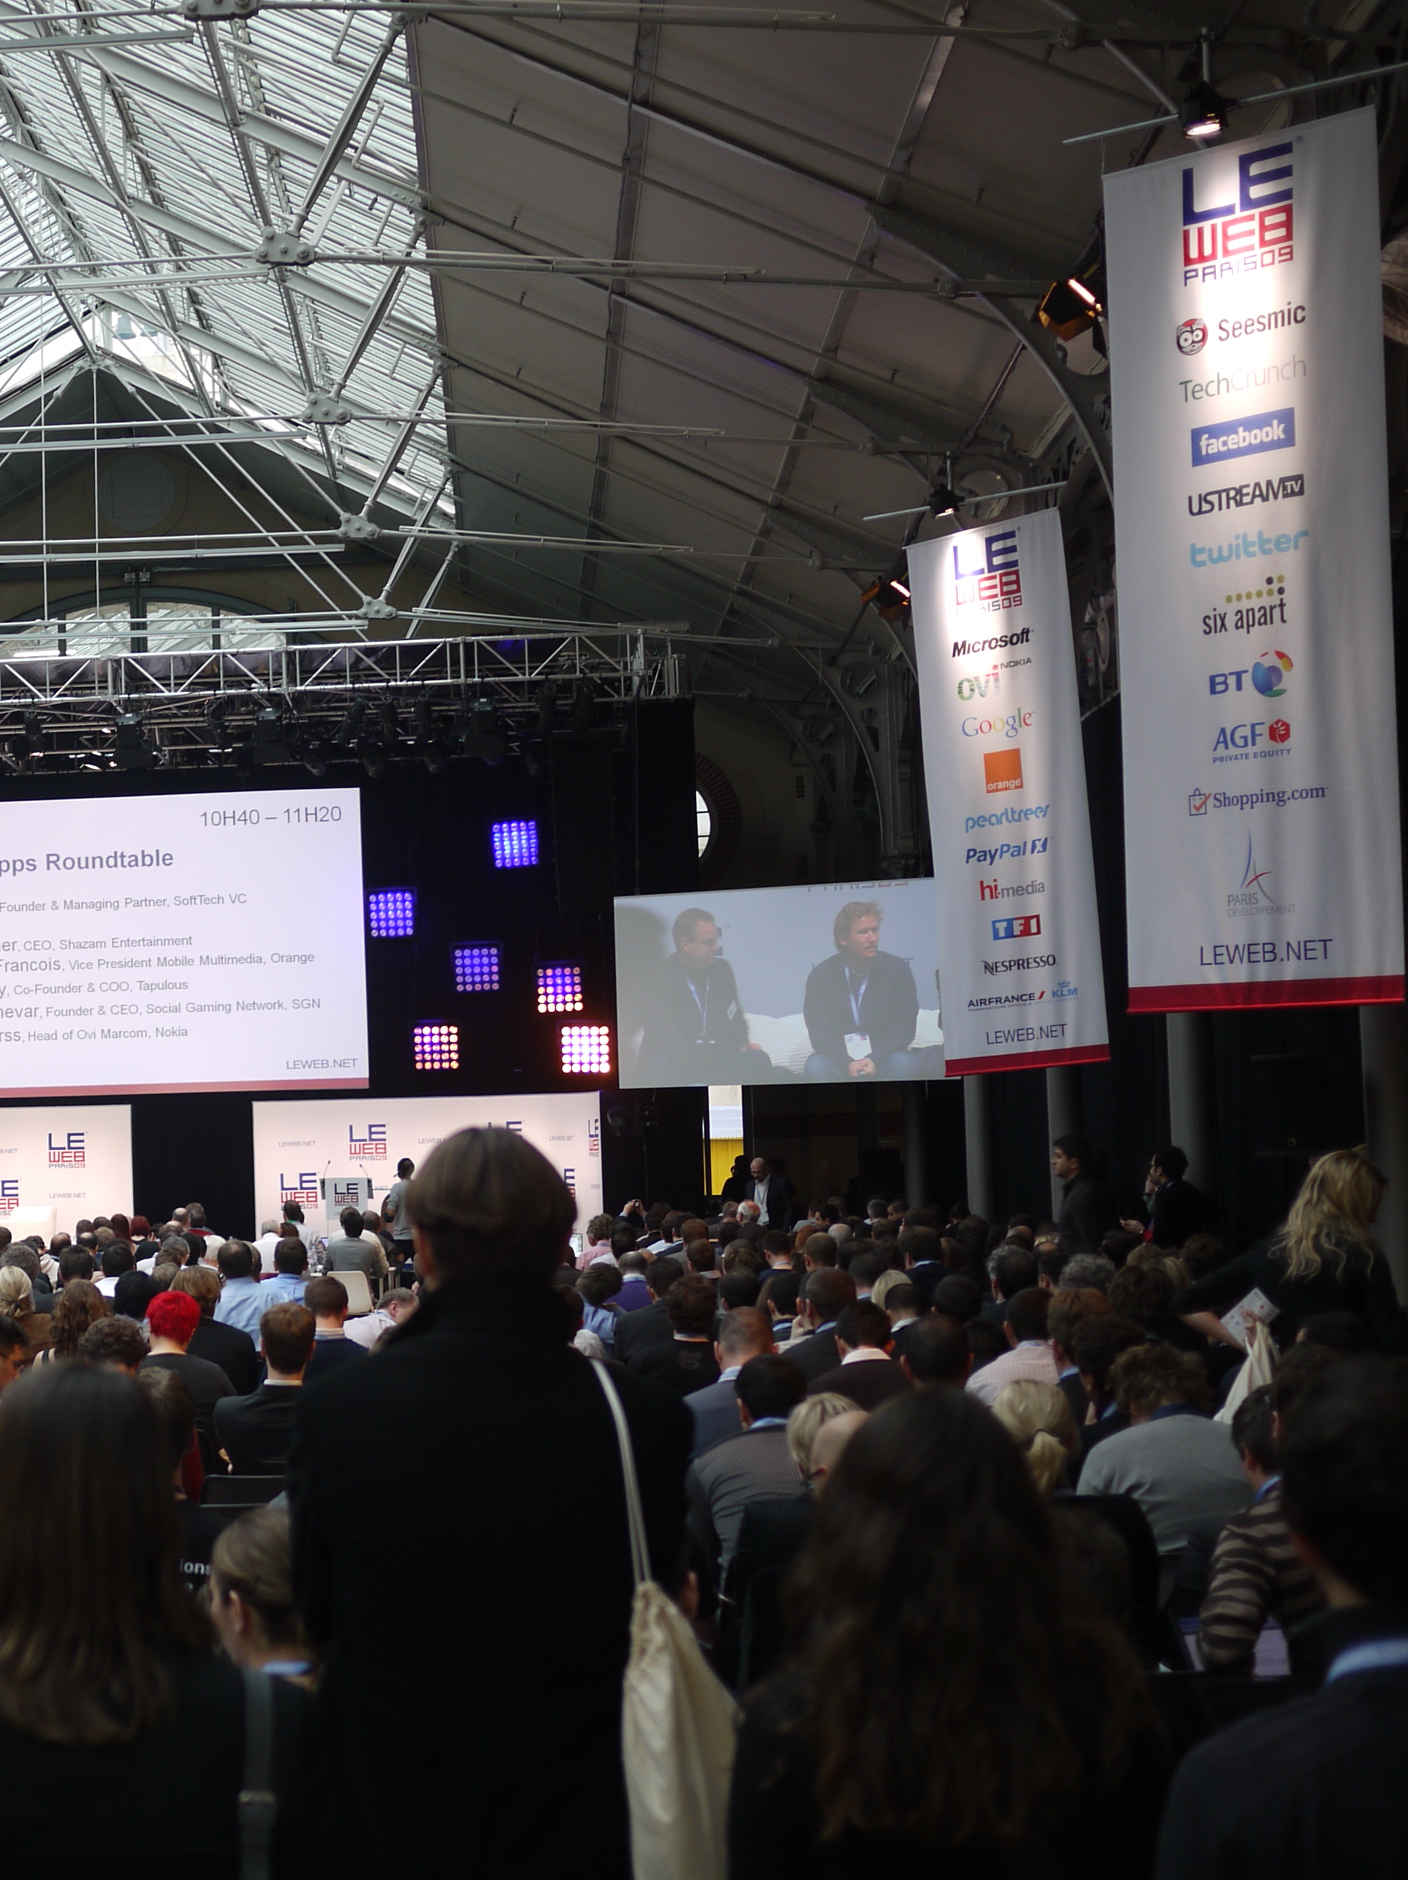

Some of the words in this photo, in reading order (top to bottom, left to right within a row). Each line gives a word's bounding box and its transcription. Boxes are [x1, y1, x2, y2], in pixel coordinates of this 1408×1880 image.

[1183, 141, 1293, 226] LE
[1183, 203, 1293, 267] WEB
[1184, 244, 1293, 287] PARIS09
[1218, 302, 1307, 342] Seesmic
[1179, 355, 1307, 403] TechCrunch
[1200, 419, 1285, 456] facebook
[953, 530, 1019, 580] LE
[1190, 529, 1310, 568] twitter
[956, 570, 1021, 606] WEB
[1203, 607, 1228, 635] six
[1234, 598, 1287, 634] apart
[952, 627, 1031, 658] Microsoft
[1000, 658, 1032, 669] NOKIA
[1209, 670, 1249, 695] BT
[962, 707, 1033, 738] Google
[1213, 722, 1265, 752] AGF
[1213, 752, 1250, 763] PRIVATE
[1253, 748, 1292, 759] EQUITY
[988, 779, 1021, 791] orange
[1213, 786, 1326, 810] Shopping.com
[200, 810, 260, 827] 10H40
[283, 806, 342, 823] 11H20
[965, 804, 1050, 833] pearltrees
[45, 849, 174, 871] Roundtable
[965, 841, 1027, 866] PayPal
[0, 901, 46, 912] Founder
[51, 901, 59, 910] &
[63, 898, 119, 911] Managing
[125, 897, 170, 908] Partner,
[173, 893, 224, 906] SoftTech
[228, 893, 247, 904] VC
[1228, 893, 1259, 907] PARIS
[994, 917, 1038, 938] TF1
[23, 940, 55, 952] CEO,
[59, 939, 107, 950] Shazam
[111, 935, 193, 948] Entertainment
[1200, 939, 1333, 966] LEWEB.NET
[68, 959, 93, 970] Vice
[97, 958, 152, 970] President
[157, 956, 194, 967] Mobile
[199, 954, 266, 967] Multimedia,
[271, 952, 315, 965] Orange
[981, 954, 1056, 975] NESPRESSO
[14, 984, 82, 995] Co-Founder
[86, 982, 95, 992] &
[99, 981, 133, 993] COO,
[136, 979, 188, 993] Tapulous
[1052, 987, 1078, 999] KLM
[46, 1005, 92, 1017] Founder
[97, 1005, 106, 1015] &
[110, 1004, 142, 1016] CEO,
[146, 1002, 181, 1014] Social
[185, 1001, 231, 1015] Gaming
[236, 999, 287, 1011] Network,
[292, 998, 321, 1009] SGN
[27, 1030, 57, 1041] Head
[62, 1029, 73, 1040] of
[76, 1029, 96, 1040] Ovi
[100, 1028, 151, 1039] Marcom,
[155, 1026, 188, 1038] Nokia
[986, 1023, 1067, 1044] LEWEB.NET
[286, 1058, 358, 1070] LEWEB.NET
[48, 1133, 84, 1150] LE
[349, 1124, 386, 1142] LE
[49, 1151, 85, 1162] WEB
[349, 1143, 387, 1155] WEB
[280, 1173, 317, 1191] LE
[334, 1183, 358, 1194] LE
[280, 1191, 318, 1204] WEB
[334, 1195, 358, 1203] WEB
